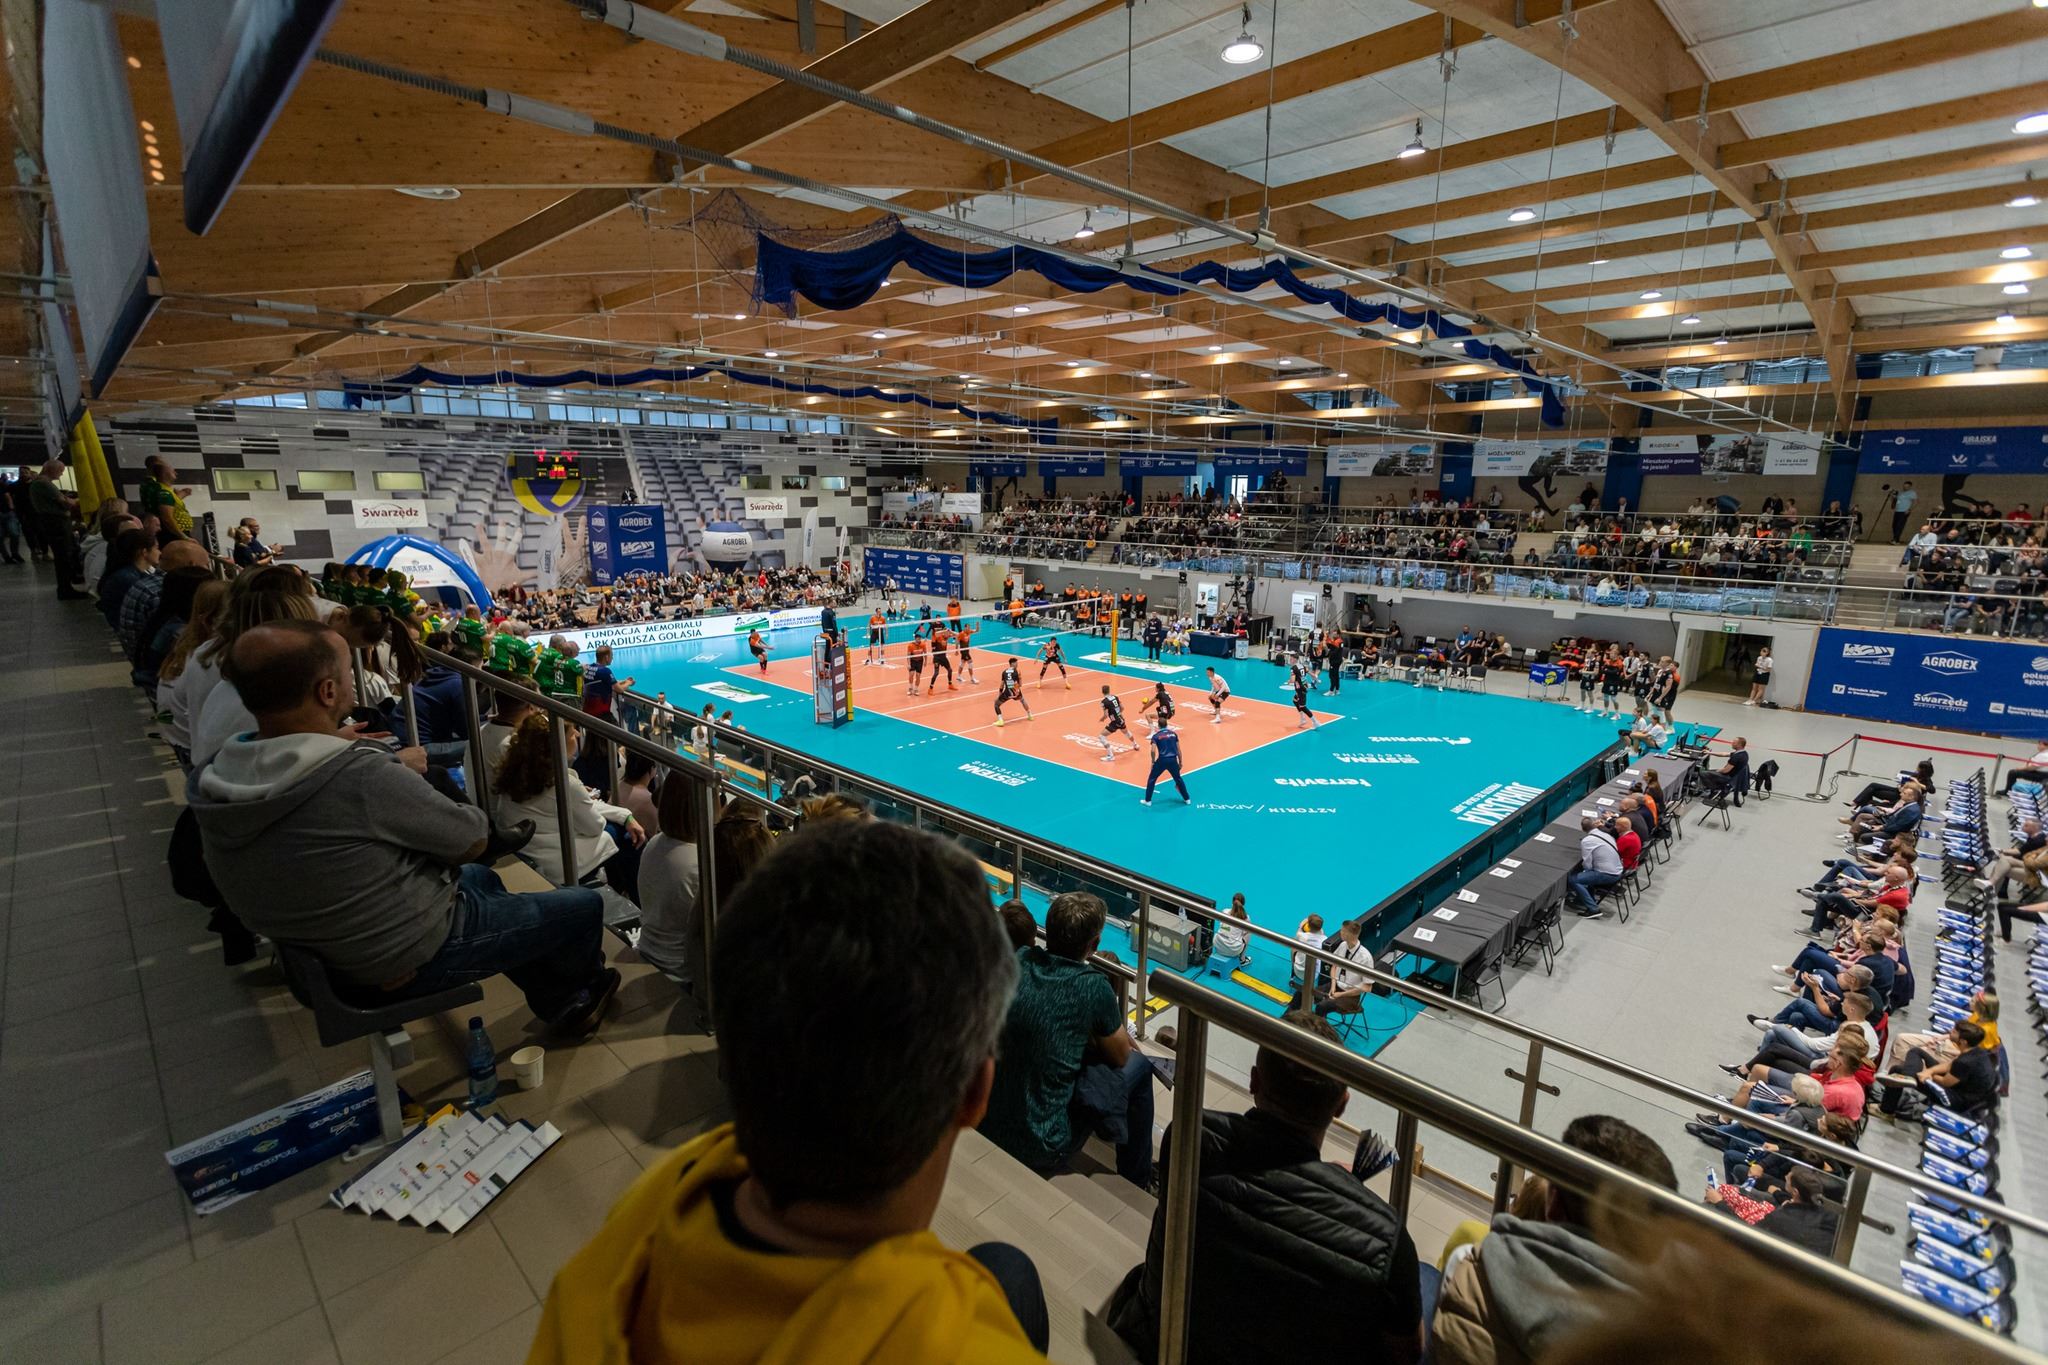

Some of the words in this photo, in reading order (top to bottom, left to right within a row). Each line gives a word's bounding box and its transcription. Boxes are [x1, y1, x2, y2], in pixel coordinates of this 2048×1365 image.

[362, 507, 419, 518] Swarzędz
[750, 502, 784, 512] Swarzędz
[619, 517, 653, 527] AGROBEX
[585, 627, 641, 639] FUNDACJA
[586, 634, 656, 650] ARKADIUSZA
[1922, 656, 1978, 671] AGROBEX
[1007, 672, 1012, 680] 5
[1913, 693, 1968, 707] Swarzędz
[957, 763, 1012, 782] STENA
[1273, 778, 1372, 788] terravita
[1456, 781, 1546, 827] JURAJSKA
